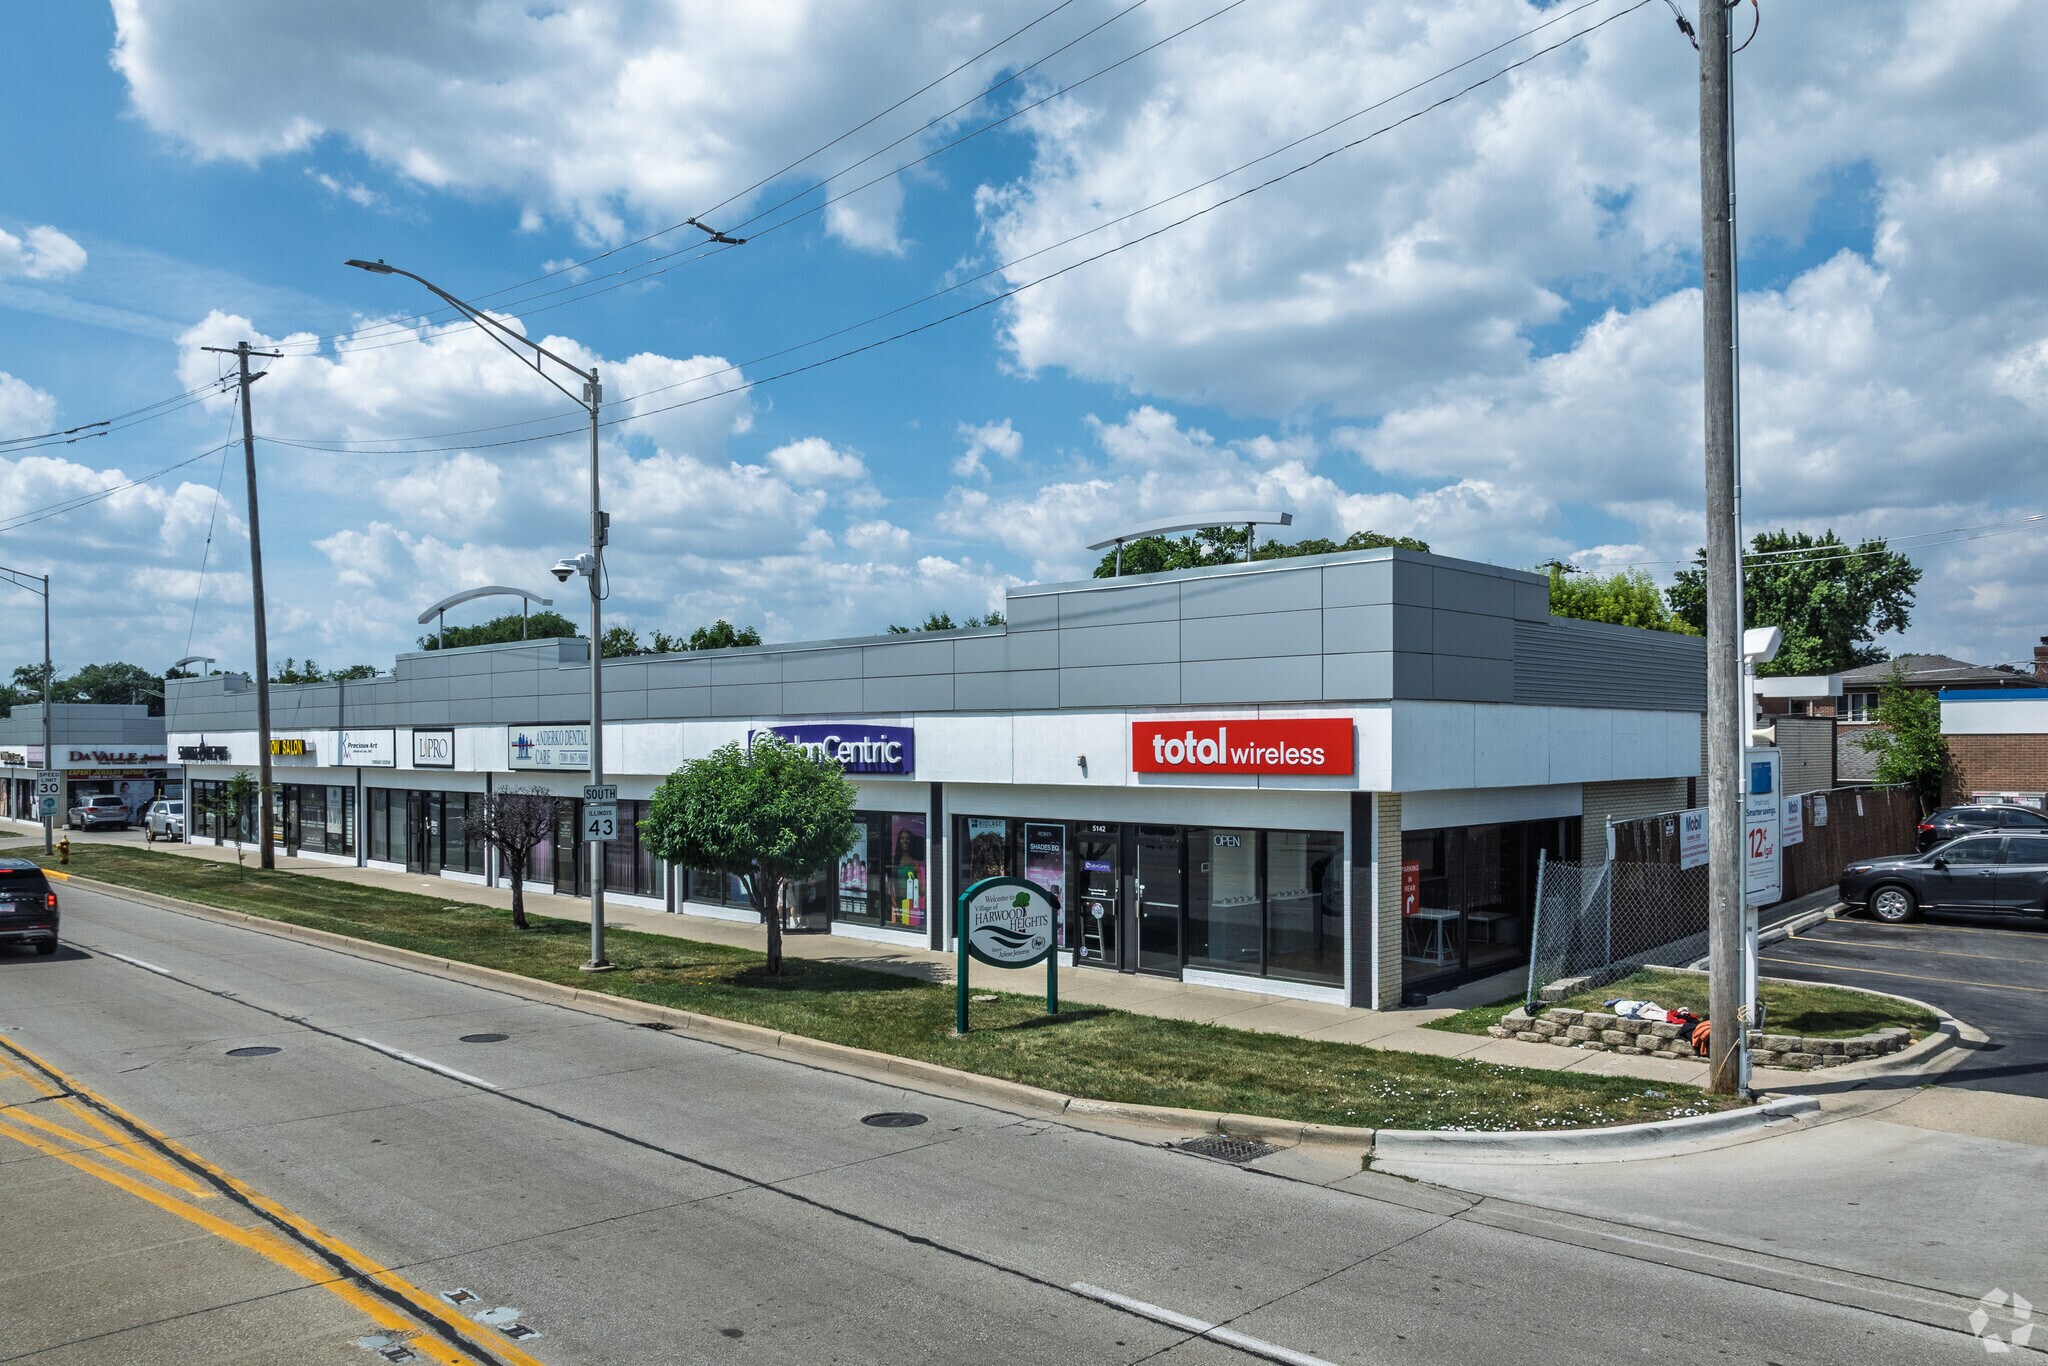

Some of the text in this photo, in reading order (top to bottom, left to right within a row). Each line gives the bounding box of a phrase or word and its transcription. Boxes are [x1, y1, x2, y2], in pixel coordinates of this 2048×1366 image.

[536, 730, 588, 746] ANDERKO DENTAL
[271, 740, 303, 755] OW SALON
[1153, 727, 1325, 765] total wireless
[535, 749, 551, 764] CARE
[40, 783, 59, 793] 30
[586, 788, 616, 800] SOUTH
[1746, 808, 1762, 817] Smarter
[588, 819, 613, 836] 43
[979, 819, 1002, 827] BIOLAGE
[1685, 814, 1702, 832] Mobil
[1030, 843, 1051, 851] SHADES
[1213, 834, 1240, 847] OPEN
[1404, 884, 1416, 892] REAR
[974, 905, 992, 913] Village
[975, 908, 1023, 926] HARWOOD
[1010, 915, 1048, 931] HEIGHTS
